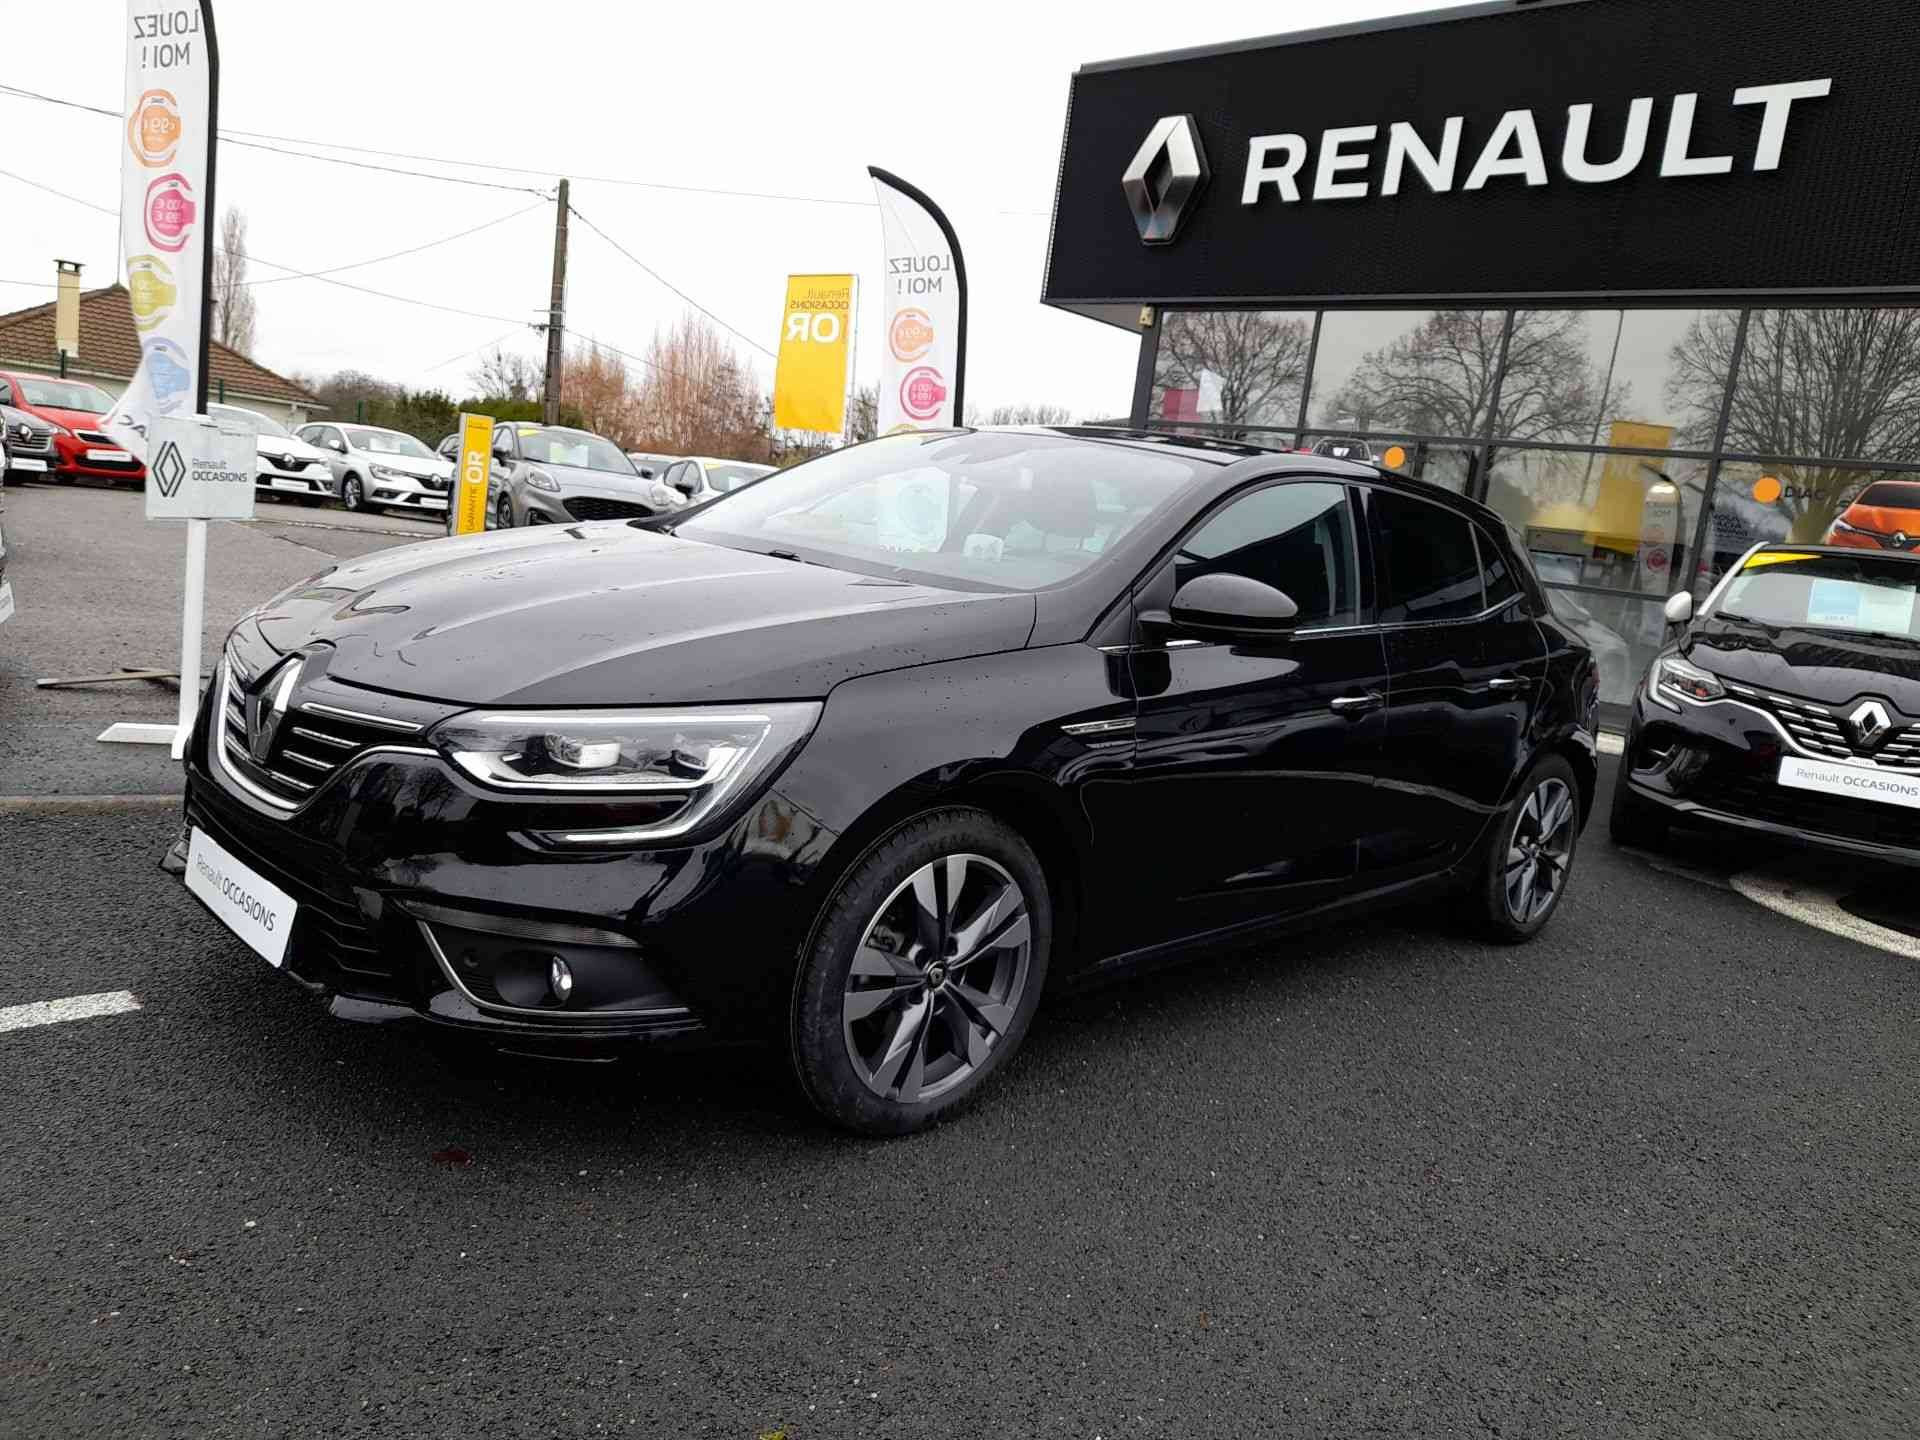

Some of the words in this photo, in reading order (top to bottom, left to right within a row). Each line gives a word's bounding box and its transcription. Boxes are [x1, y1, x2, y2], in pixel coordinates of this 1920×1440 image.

[1240, 78, 1833, 206] RENAULT
[191, 457, 227, 470] Renault
[191, 471, 248, 482] OCCASIONS
[465, 450, 484, 484] OR
[1795, 767, 1840, 783] Renault
[1843, 775, 1919, 797] OCCASIONS
[197, 853, 222, 890] Renault
[222, 877, 277, 932] OCCASIONS
